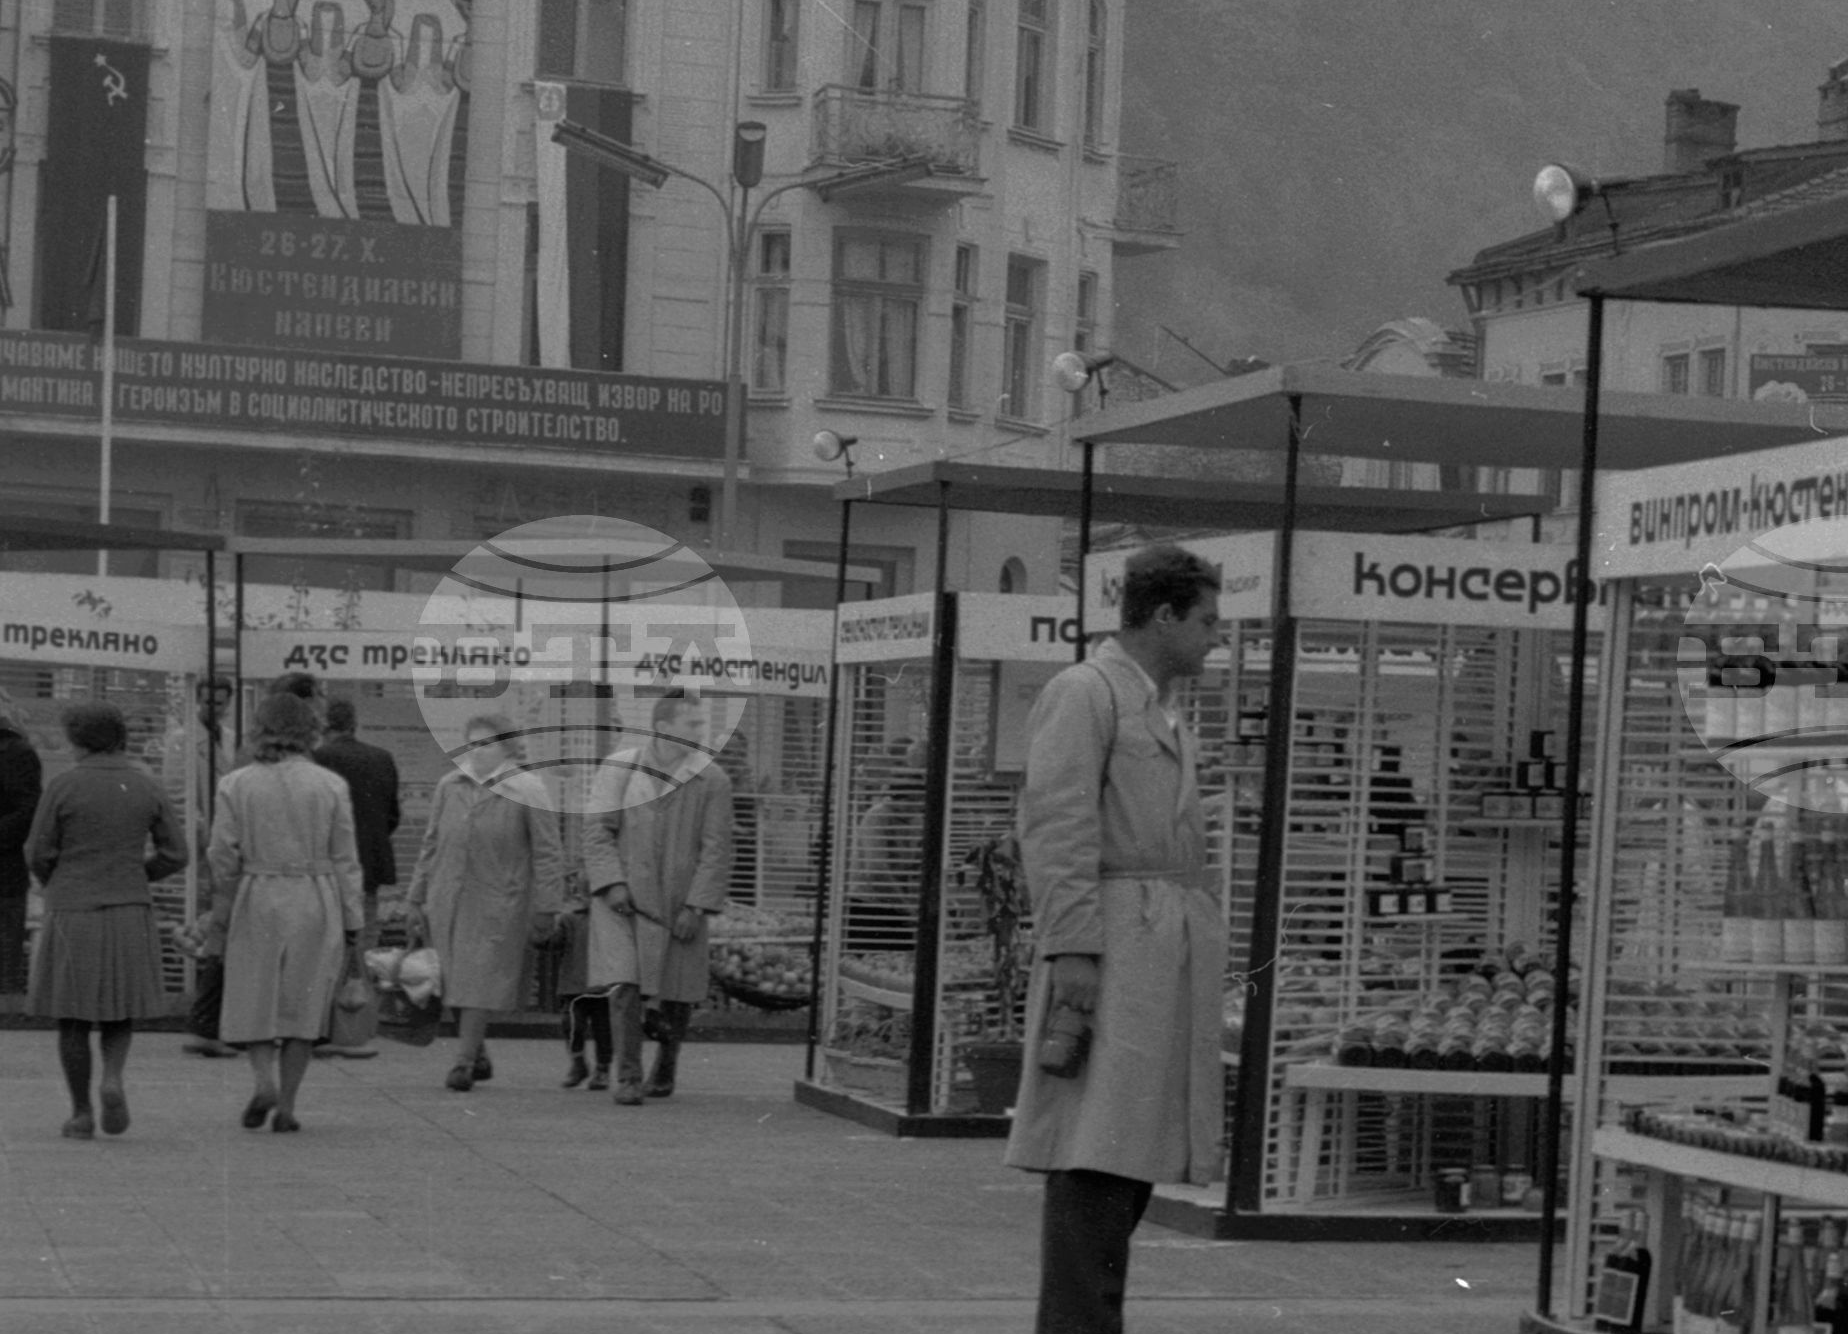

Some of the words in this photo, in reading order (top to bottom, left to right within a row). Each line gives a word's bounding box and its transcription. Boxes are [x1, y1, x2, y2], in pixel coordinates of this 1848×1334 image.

[1, 375, 94, 406] МАНТИКА
[119, 382, 222, 415] ГЕРОИЗЪМ
[229, 390, 241, 417] В
[248, 392, 458, 431] СОЦИАЛИСТИЧЕСКОТО
[465, 407, 627, 443] СТРОИТЕЛСТВО.
[93, 344, 173, 378] НШЕТО
[180, 352, 287, 386] КУЛТУРНО
[598, 383, 661, 411] ИЗВОР
[667, 387, 693, 413] НА
